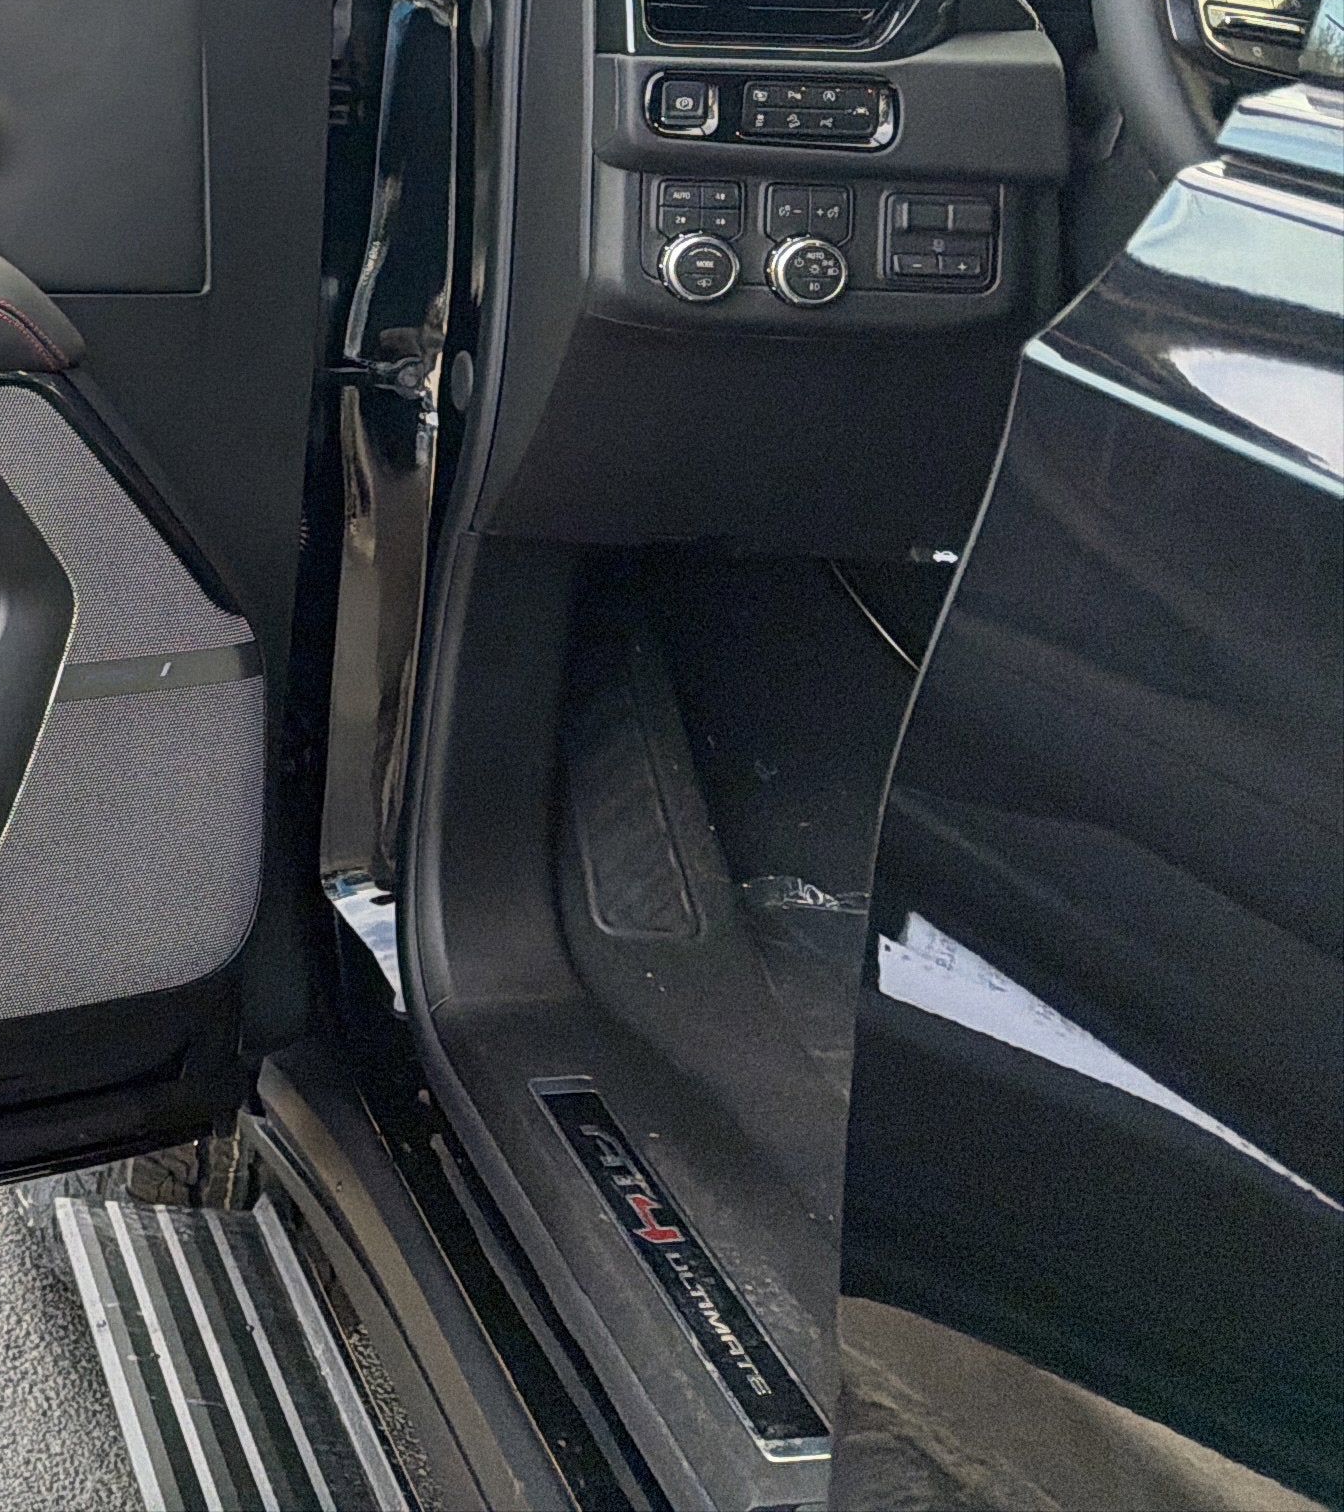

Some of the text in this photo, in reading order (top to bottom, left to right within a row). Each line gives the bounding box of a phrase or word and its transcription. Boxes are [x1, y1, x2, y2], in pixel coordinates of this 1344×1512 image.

[672, 191, 691, 200] AUTO
[806, 252, 825, 260] AUTO
[695, 260, 715, 269] MODE
[580, 1124, 686, 1244] AT4
[665, 1251, 773, 1397] ULTIMATE
